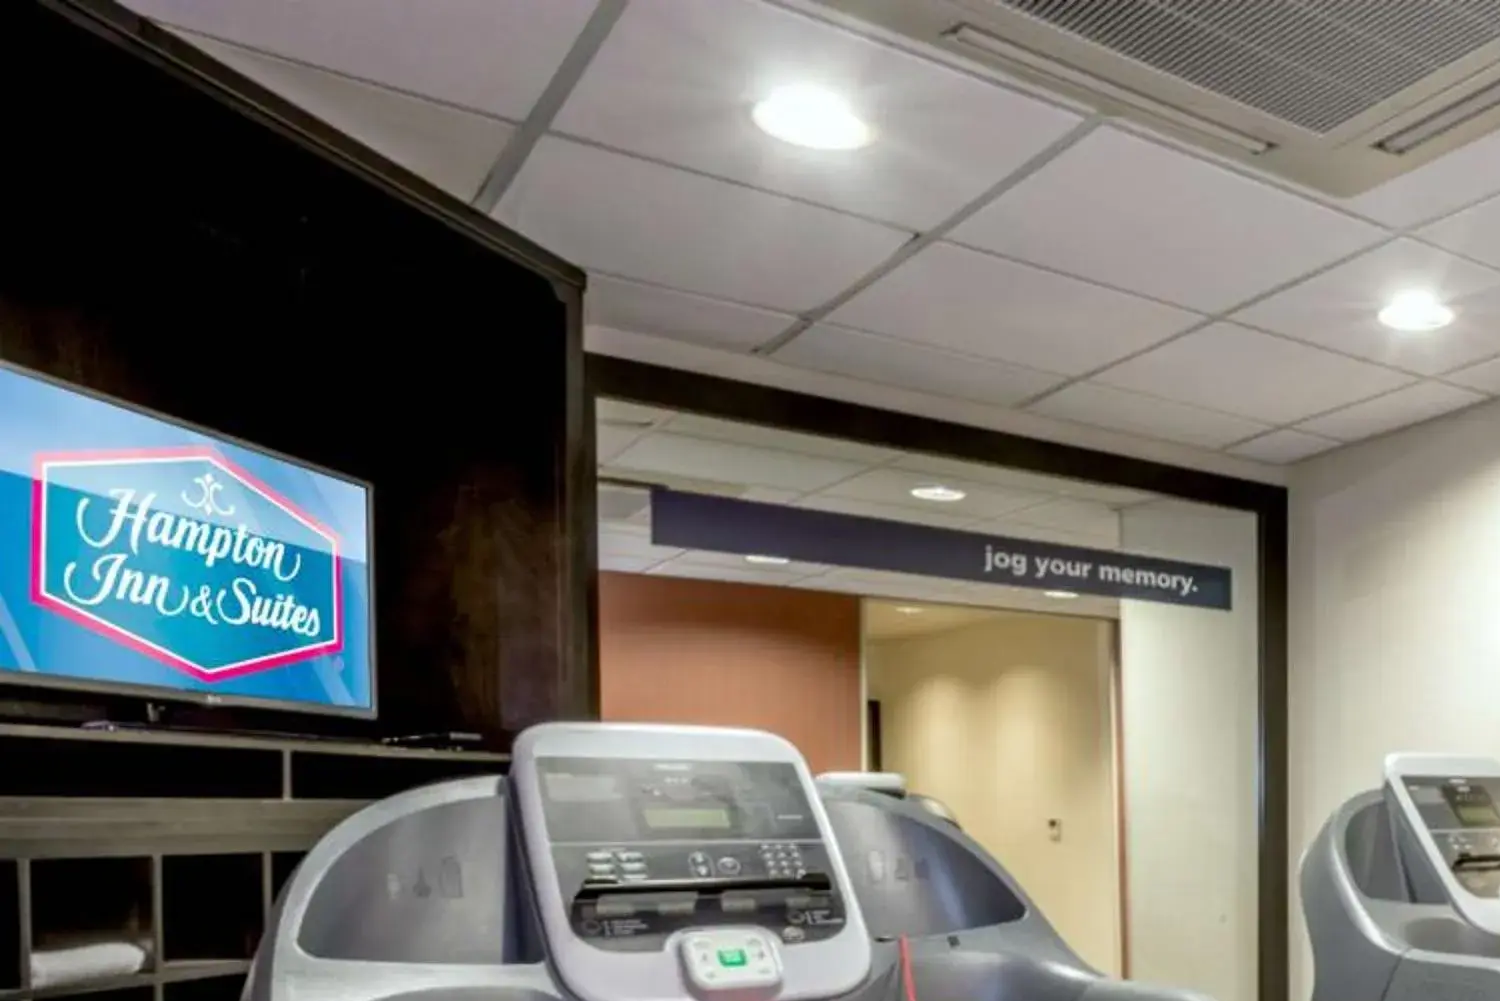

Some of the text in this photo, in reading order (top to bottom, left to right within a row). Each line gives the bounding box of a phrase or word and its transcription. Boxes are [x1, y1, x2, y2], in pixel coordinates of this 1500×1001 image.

[76, 488, 301, 582] Hampton
[984, 545, 1199, 596] jog your memory.
[63, 553, 321, 637] Inn & Suites
